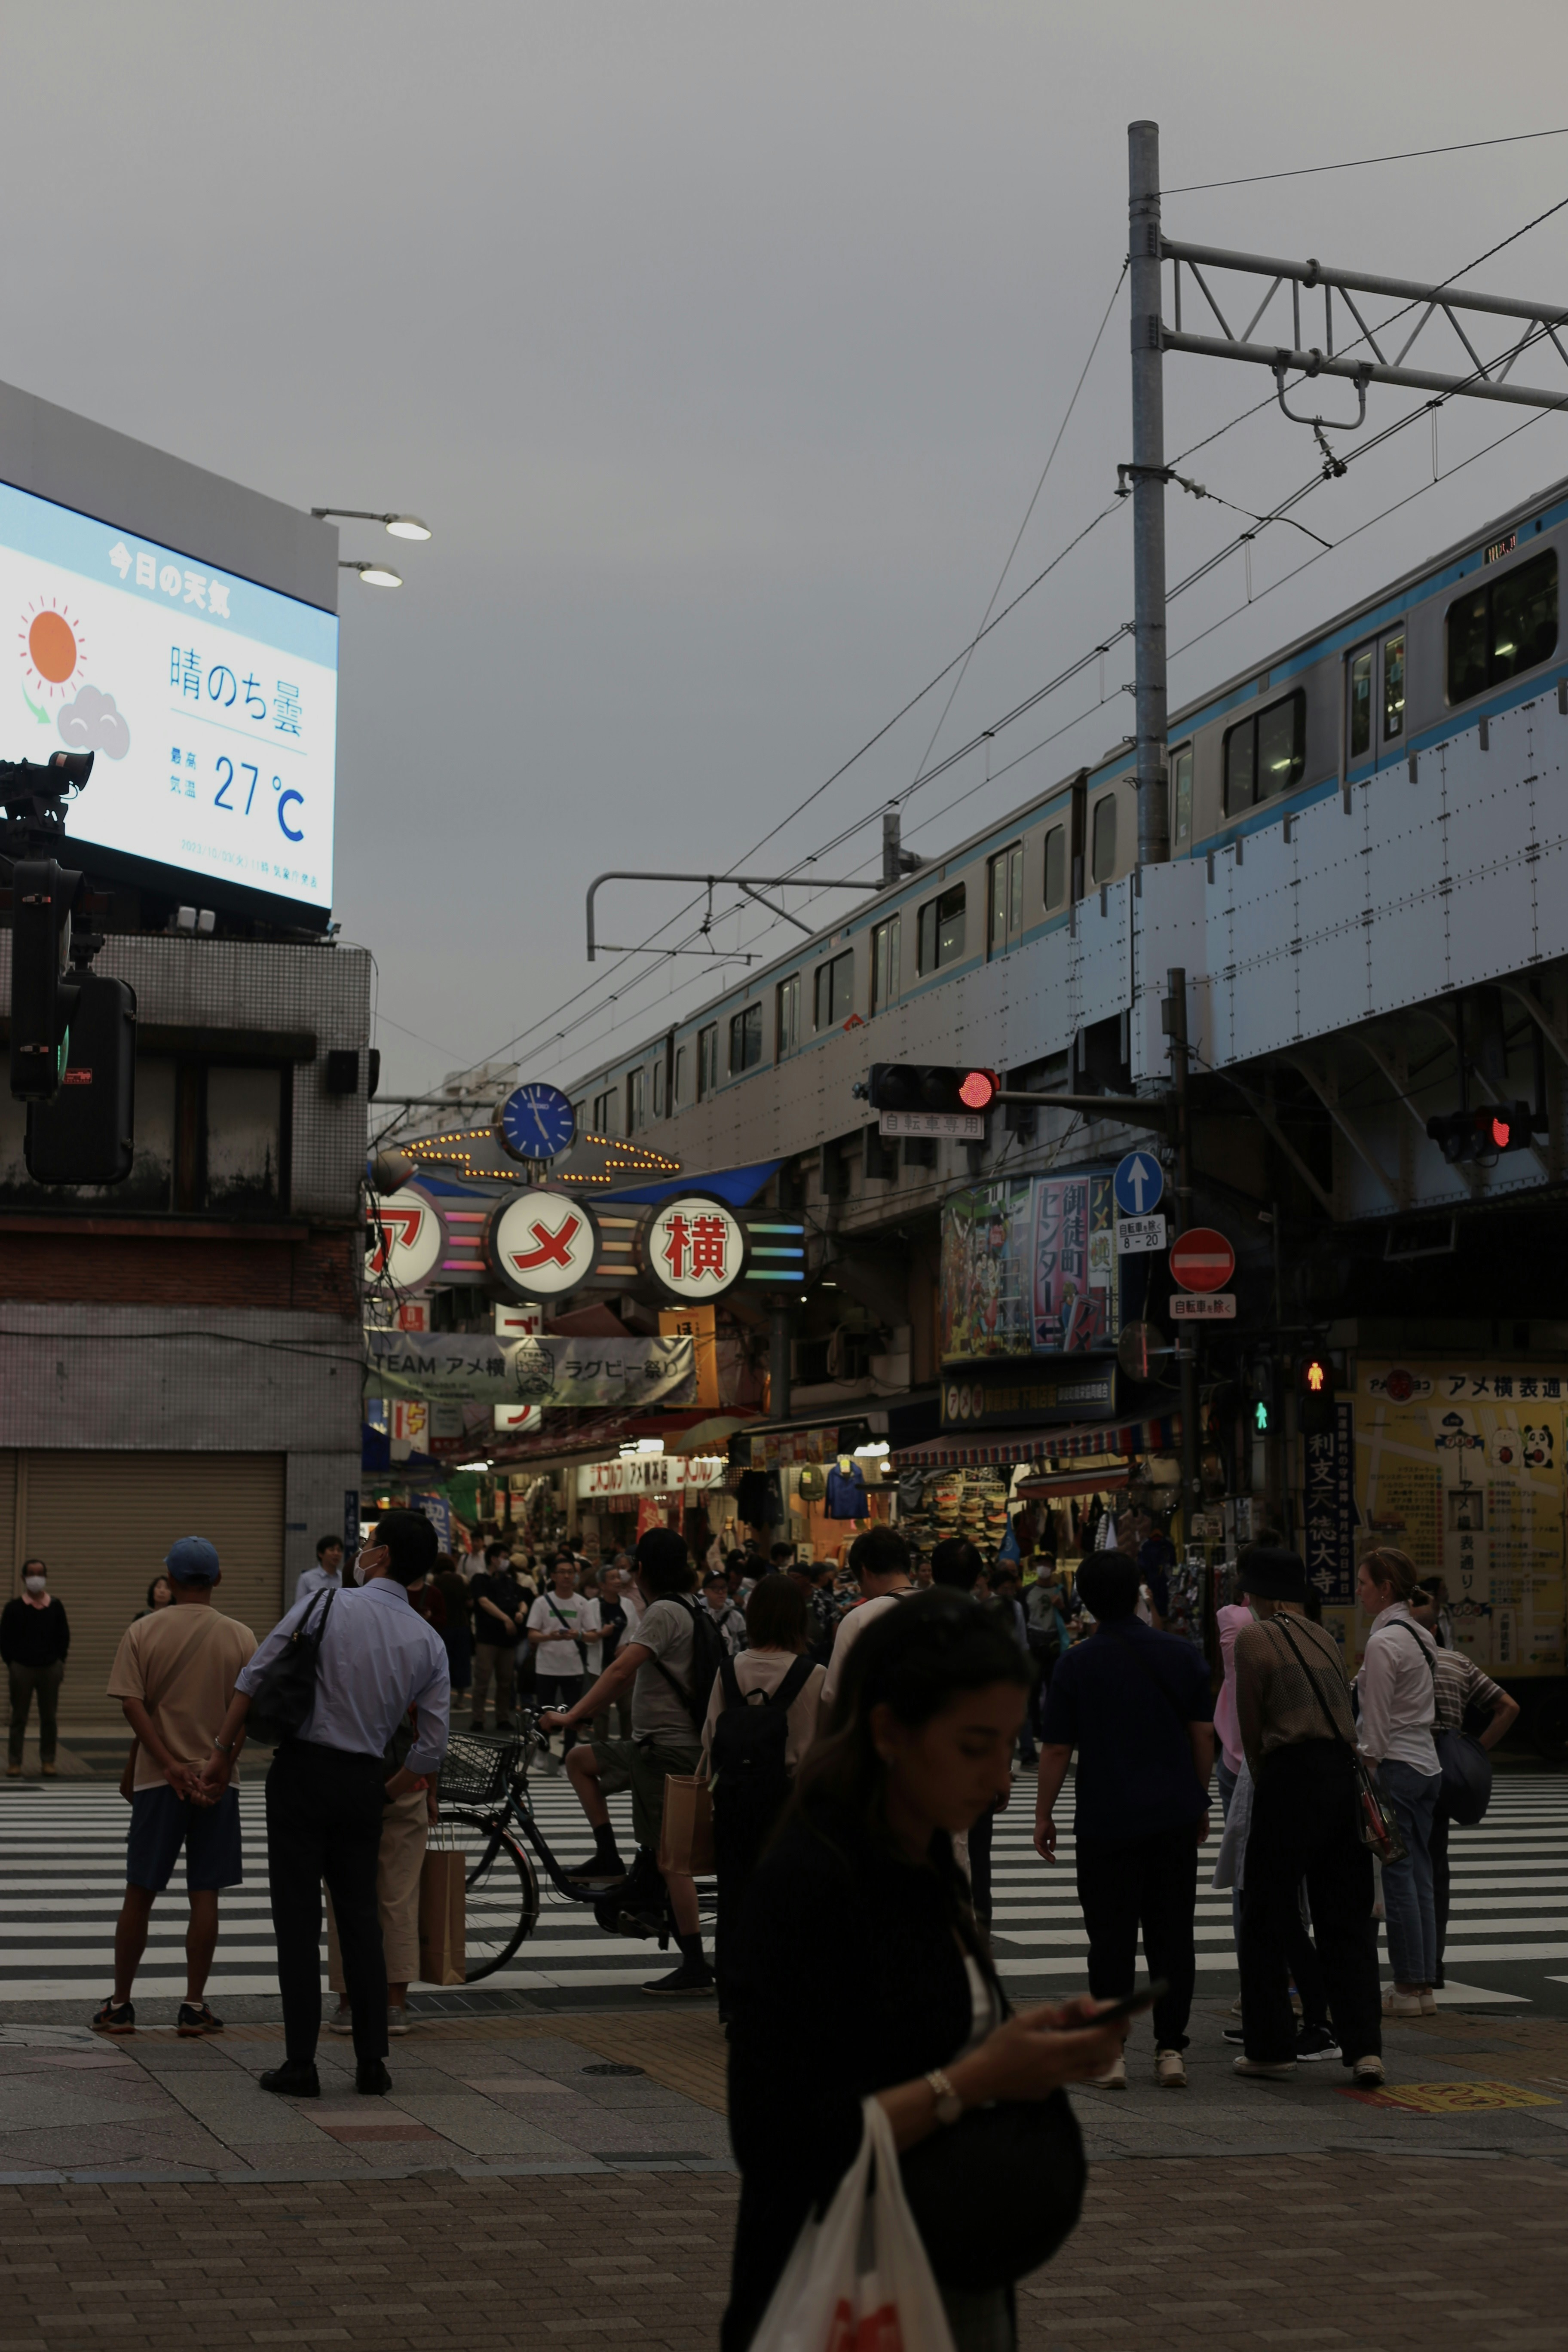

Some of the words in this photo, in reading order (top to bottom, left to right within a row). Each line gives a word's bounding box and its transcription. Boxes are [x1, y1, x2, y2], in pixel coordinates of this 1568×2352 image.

[108, 542, 231, 619] 今日の天気
[170, 646, 303, 737] 晴のち曇
[171, 746, 196, 770] 最高
[170, 775, 196, 799] 気温
[886, 1112, 979, 1133] 自転車専用
[1060, 1183, 1086, 1279] 御徒町
[1090, 1178, 1111, 1267] アメ横
[1119, 1220, 1162, 1235] 自転車を除く
[1037, 1186, 1061, 1314] センター
[1175, 1299, 1231, 1314] 自転車を除く
[374, 1354, 436, 1375] TEAM
[447, 1357, 506, 1377] アメ横
[565, 1361, 678, 1378] ラグビー祭り
[1449, 1375, 1568, 1398] アメ横表通
[1458, 1479, 1474, 1589] アメ横表通り
